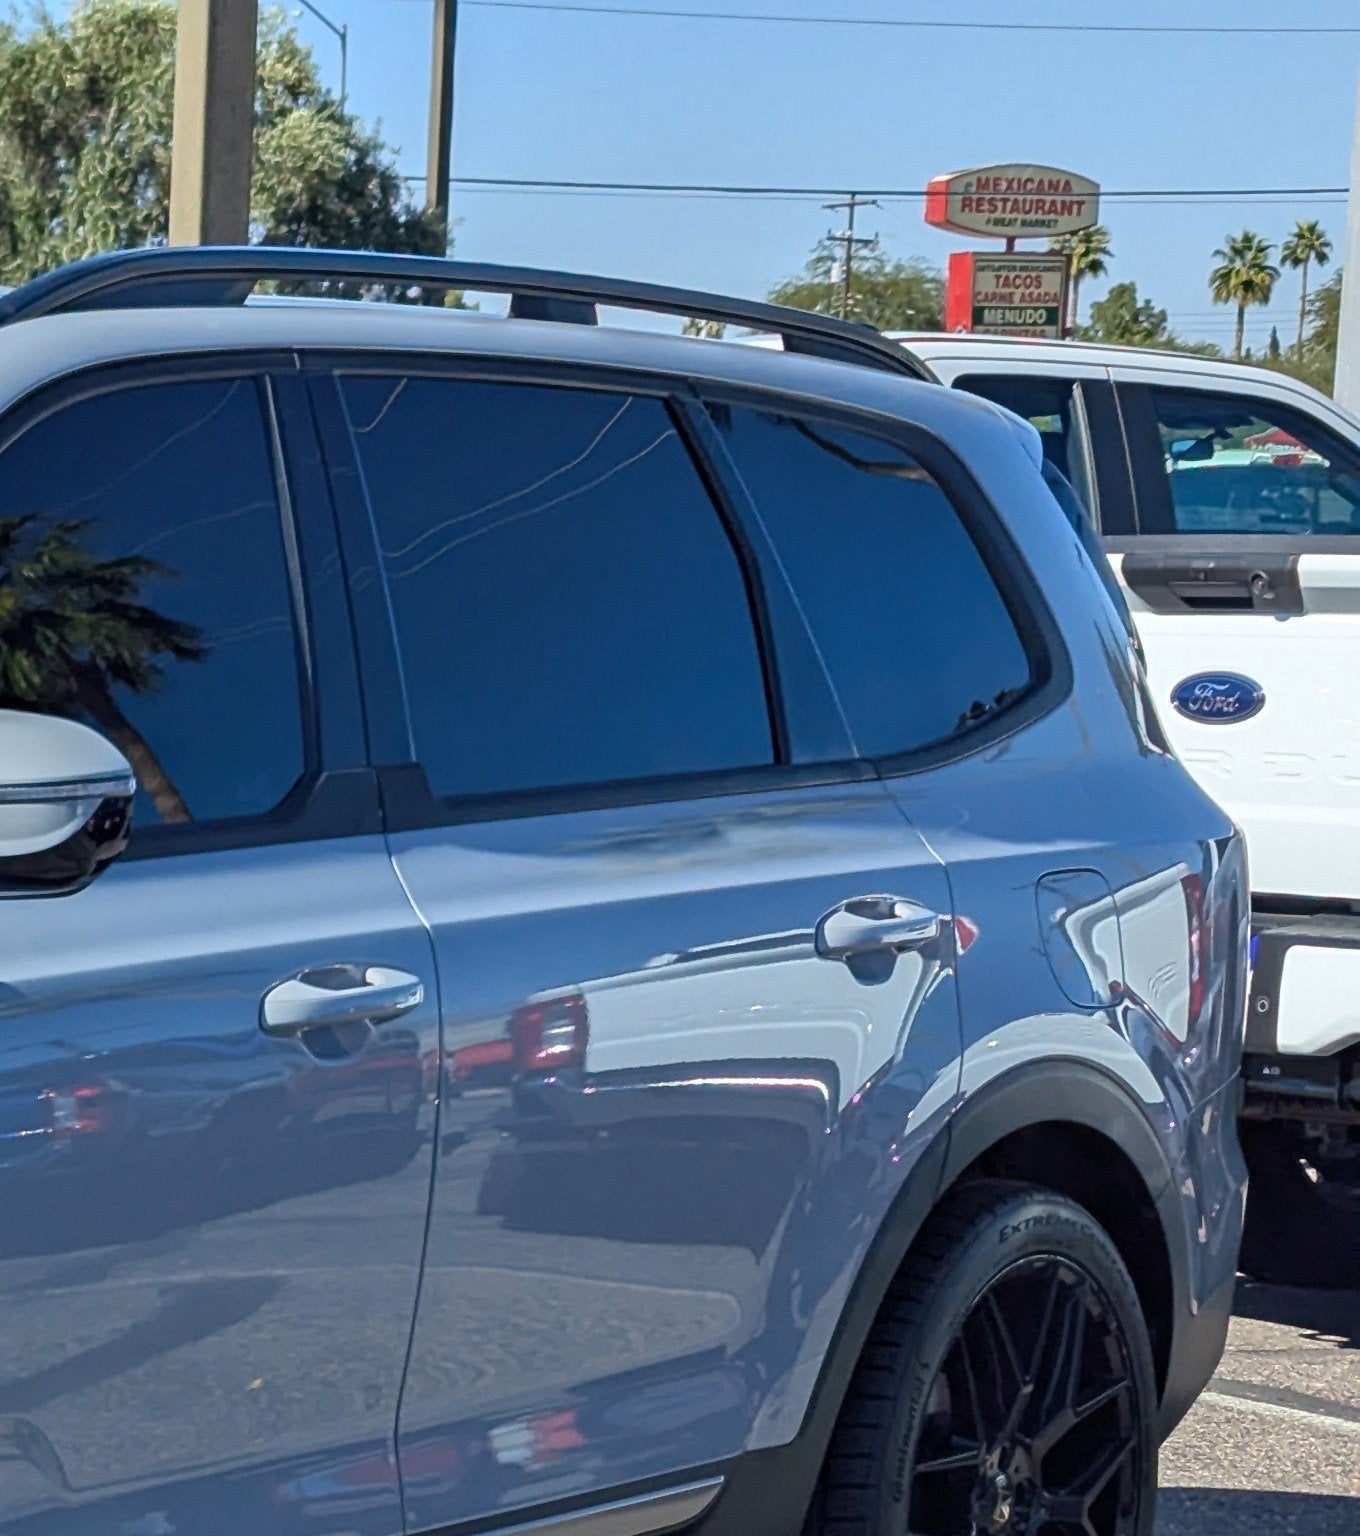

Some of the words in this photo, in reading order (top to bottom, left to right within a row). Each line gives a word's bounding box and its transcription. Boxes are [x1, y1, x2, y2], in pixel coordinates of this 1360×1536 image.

[976, 176, 1073, 193] MEXICANA
[960, 196, 1086, 216] RESTAURANT
[994, 274, 1043, 289] TACOS
[975, 291, 1015, 304] CARNE
[1018, 291, 1060, 304] ASADA
[983, 308, 1047, 324] MENUDO
